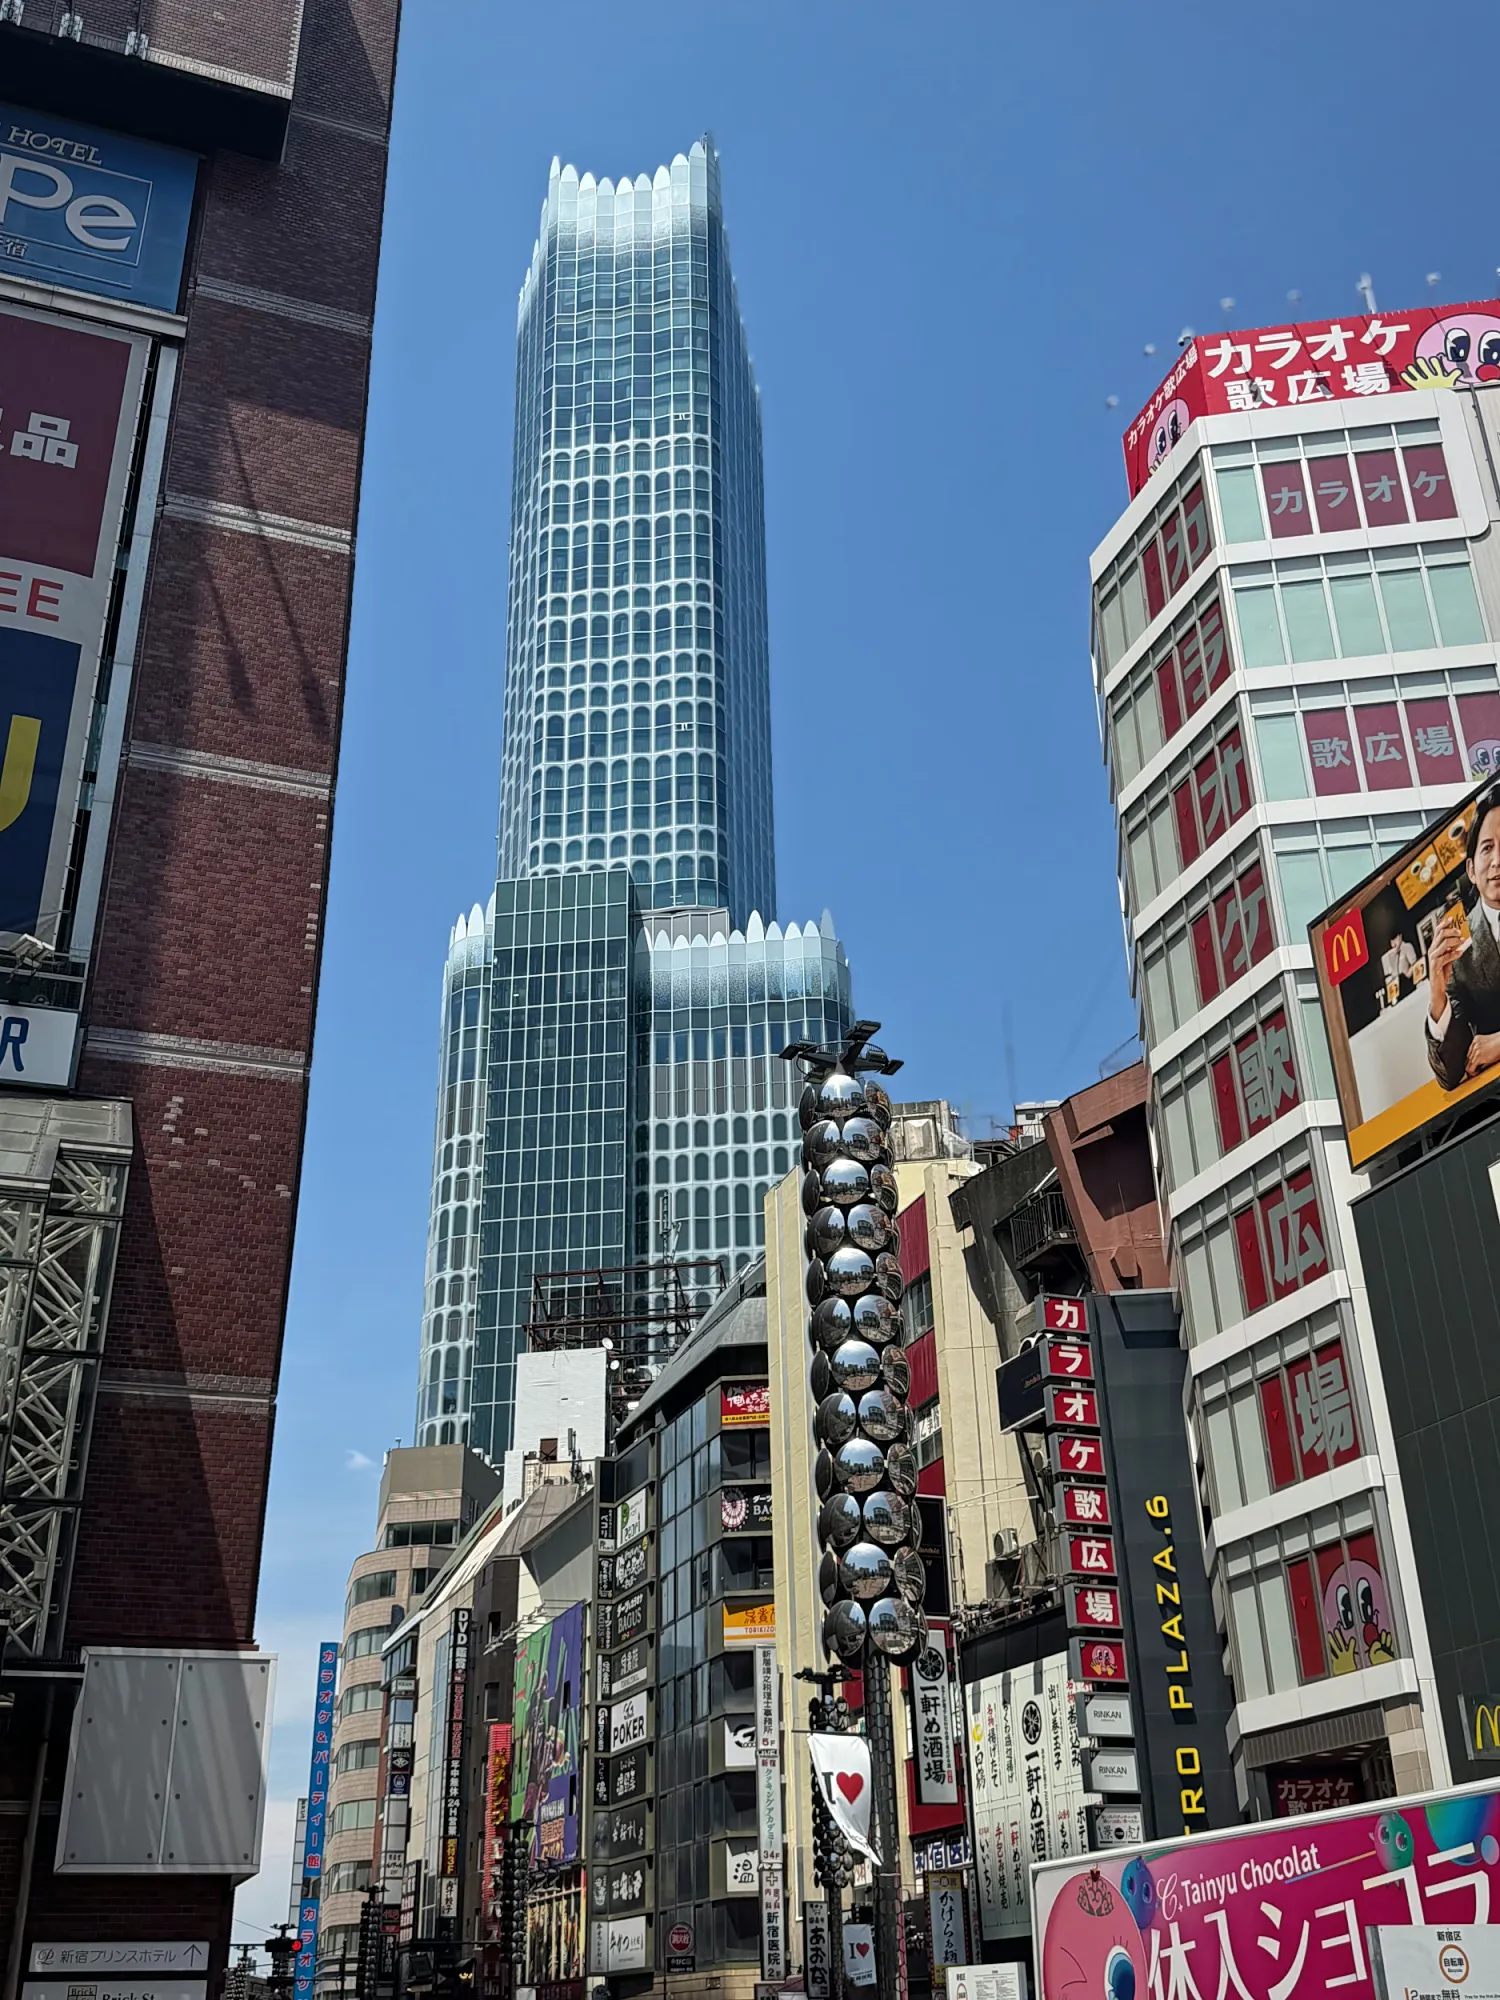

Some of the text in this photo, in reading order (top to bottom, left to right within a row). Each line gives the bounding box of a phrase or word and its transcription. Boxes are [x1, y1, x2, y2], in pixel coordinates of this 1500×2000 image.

[8, 126, 103, 166] HOTEL
[0, 237, 28, 259] 宿
[1204, 319, 1410, 379] カラオケ
[1127, 343, 1198, 451] カラオケ歌広場
[1223, 361, 1391, 412] 歌広場
[0, 408, 79, 469] 品
[1270, 470, 1447, 516] カラオケ
[1309, 725, 1455, 769] 歌広場
[0, 1016, 29, 1072] R
[1054, 1300, 1114, 1623] カラオケ歌広場
[618, 1606, 642, 1634] BAGUS
[744, 1626, 776, 1634] TORIKIZO
[613, 1715, 645, 1748] POKER
[920, 1684, 946, 1785] 一軒め酒場
[1093, 1710, 1122, 1720] RINKAN
[1098, 1765, 1128, 1775] RINKAN
[1175, 1747, 1206, 1836] RO
[1278, 1777, 1354, 1800] カラオケ
[1181, 1843, 1321, 1907] Tainyu Chocolat
[60, 1949, 177, 1964] 新宿プリンスホテル
[766, 1911, 780, 1966] 新宿医院
[1436, 1931, 1462, 1942] 新宿区
[1443, 1957, 1464, 1967] 自転車
